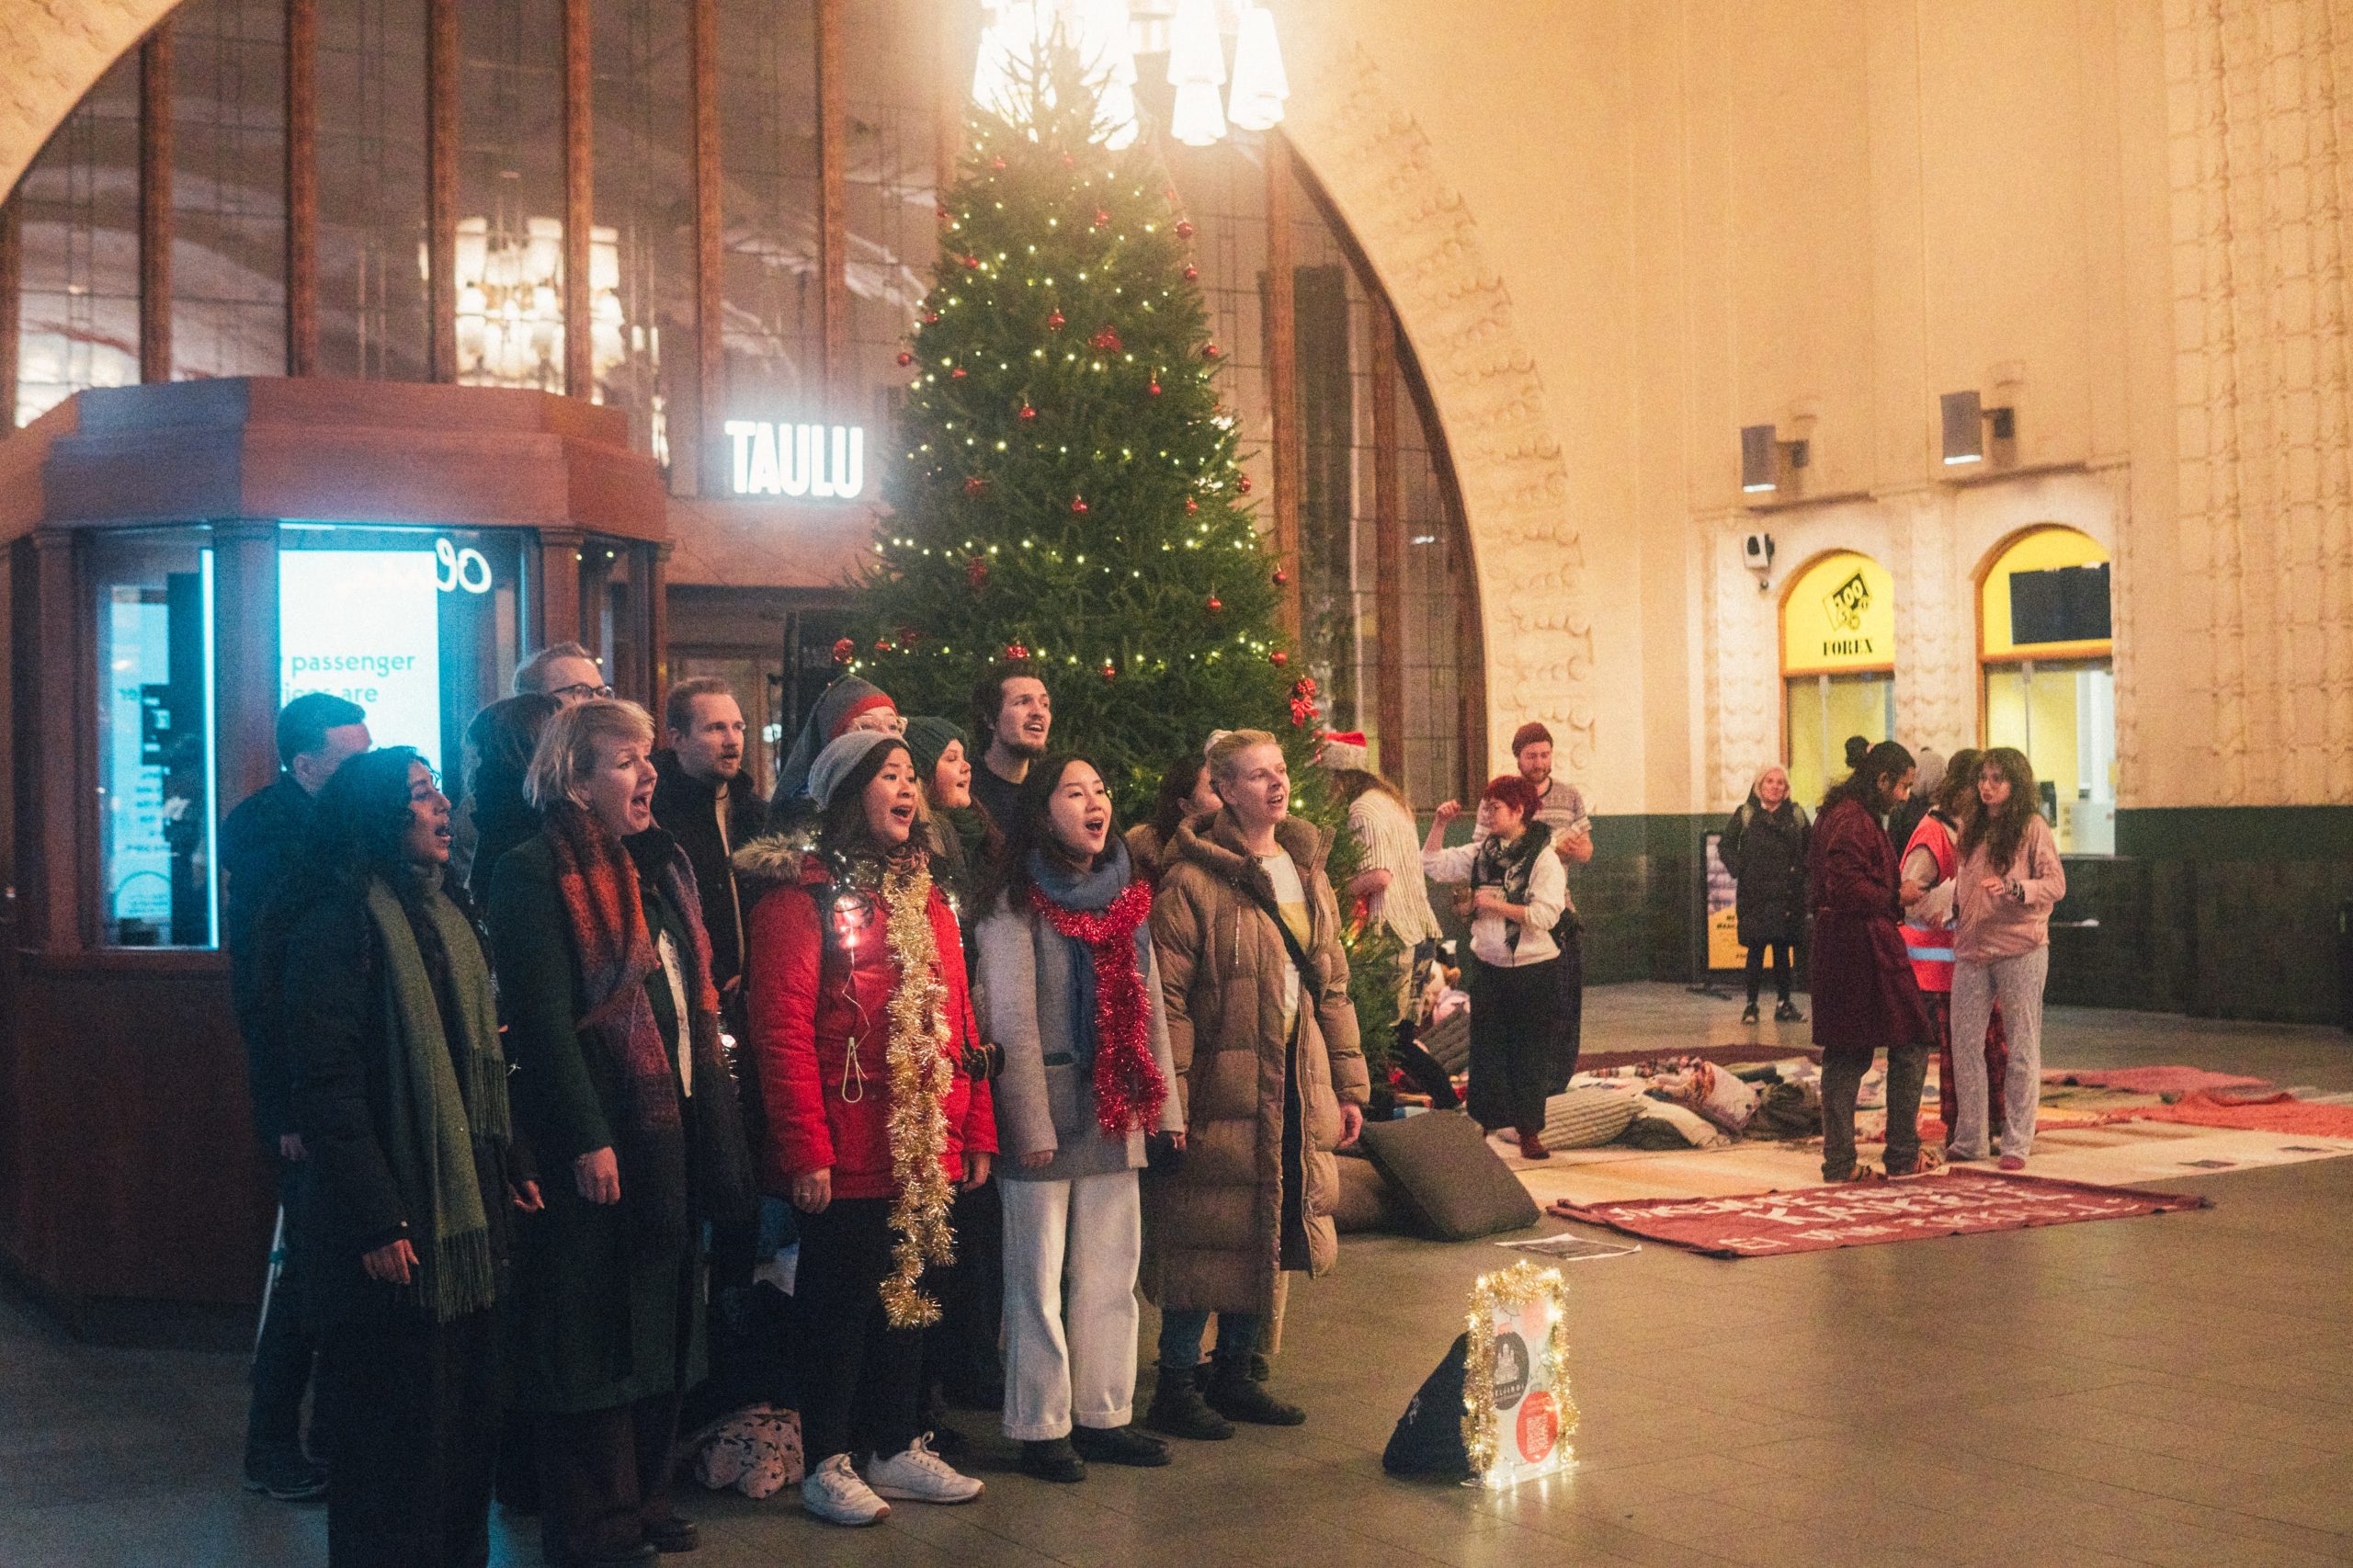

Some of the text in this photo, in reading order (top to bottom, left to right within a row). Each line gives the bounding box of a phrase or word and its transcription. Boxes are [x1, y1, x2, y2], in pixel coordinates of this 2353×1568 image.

[724, 420, 863, 499] TAULU
[1824, 639, 1872, 655] FOREX
[291, 655, 415, 678] passenger
[342, 687, 378, 702] are
